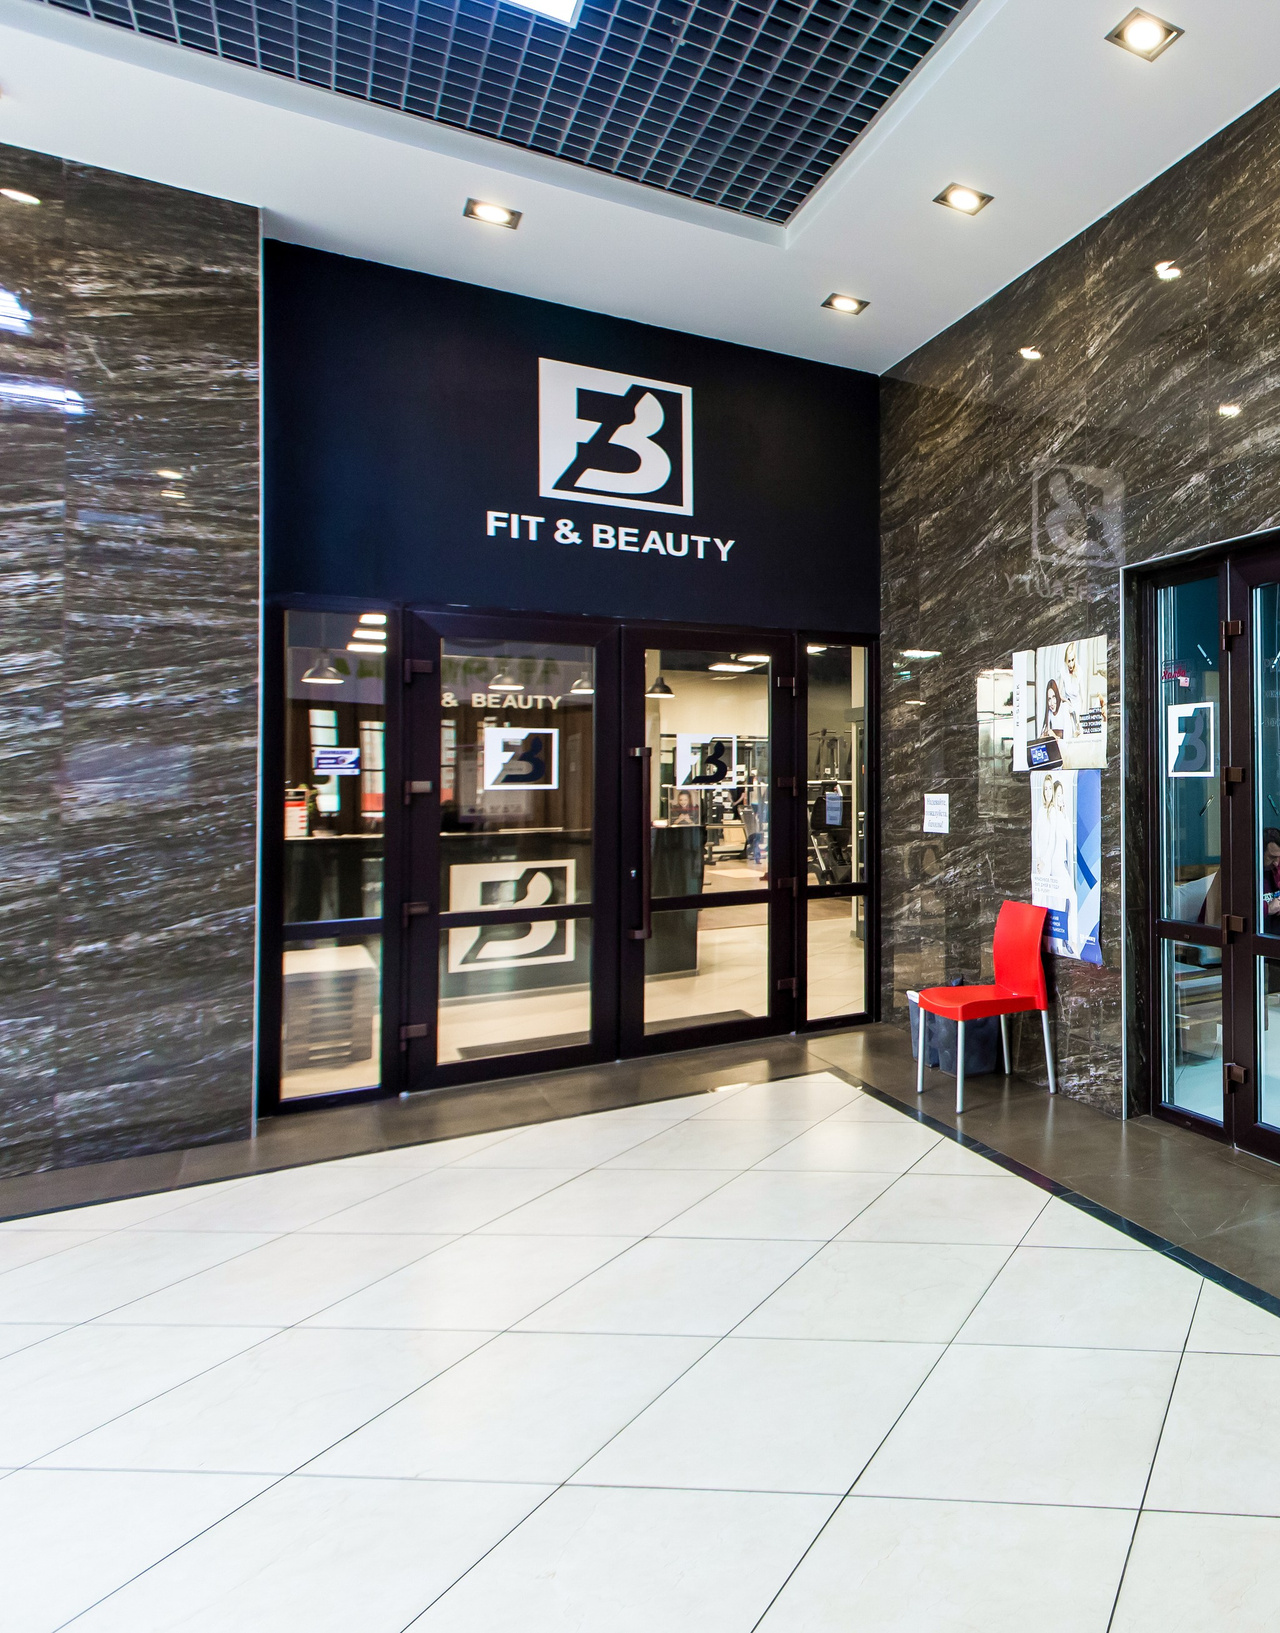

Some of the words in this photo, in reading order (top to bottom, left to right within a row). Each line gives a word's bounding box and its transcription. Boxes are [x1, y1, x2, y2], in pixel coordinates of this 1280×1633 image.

[486, 510, 545, 542] FIT
[553, 518, 583, 546] &
[592, 523, 736, 562] BEAUTY
[440, 692, 459, 708] &
[471, 693, 563, 710] BEAUTY
